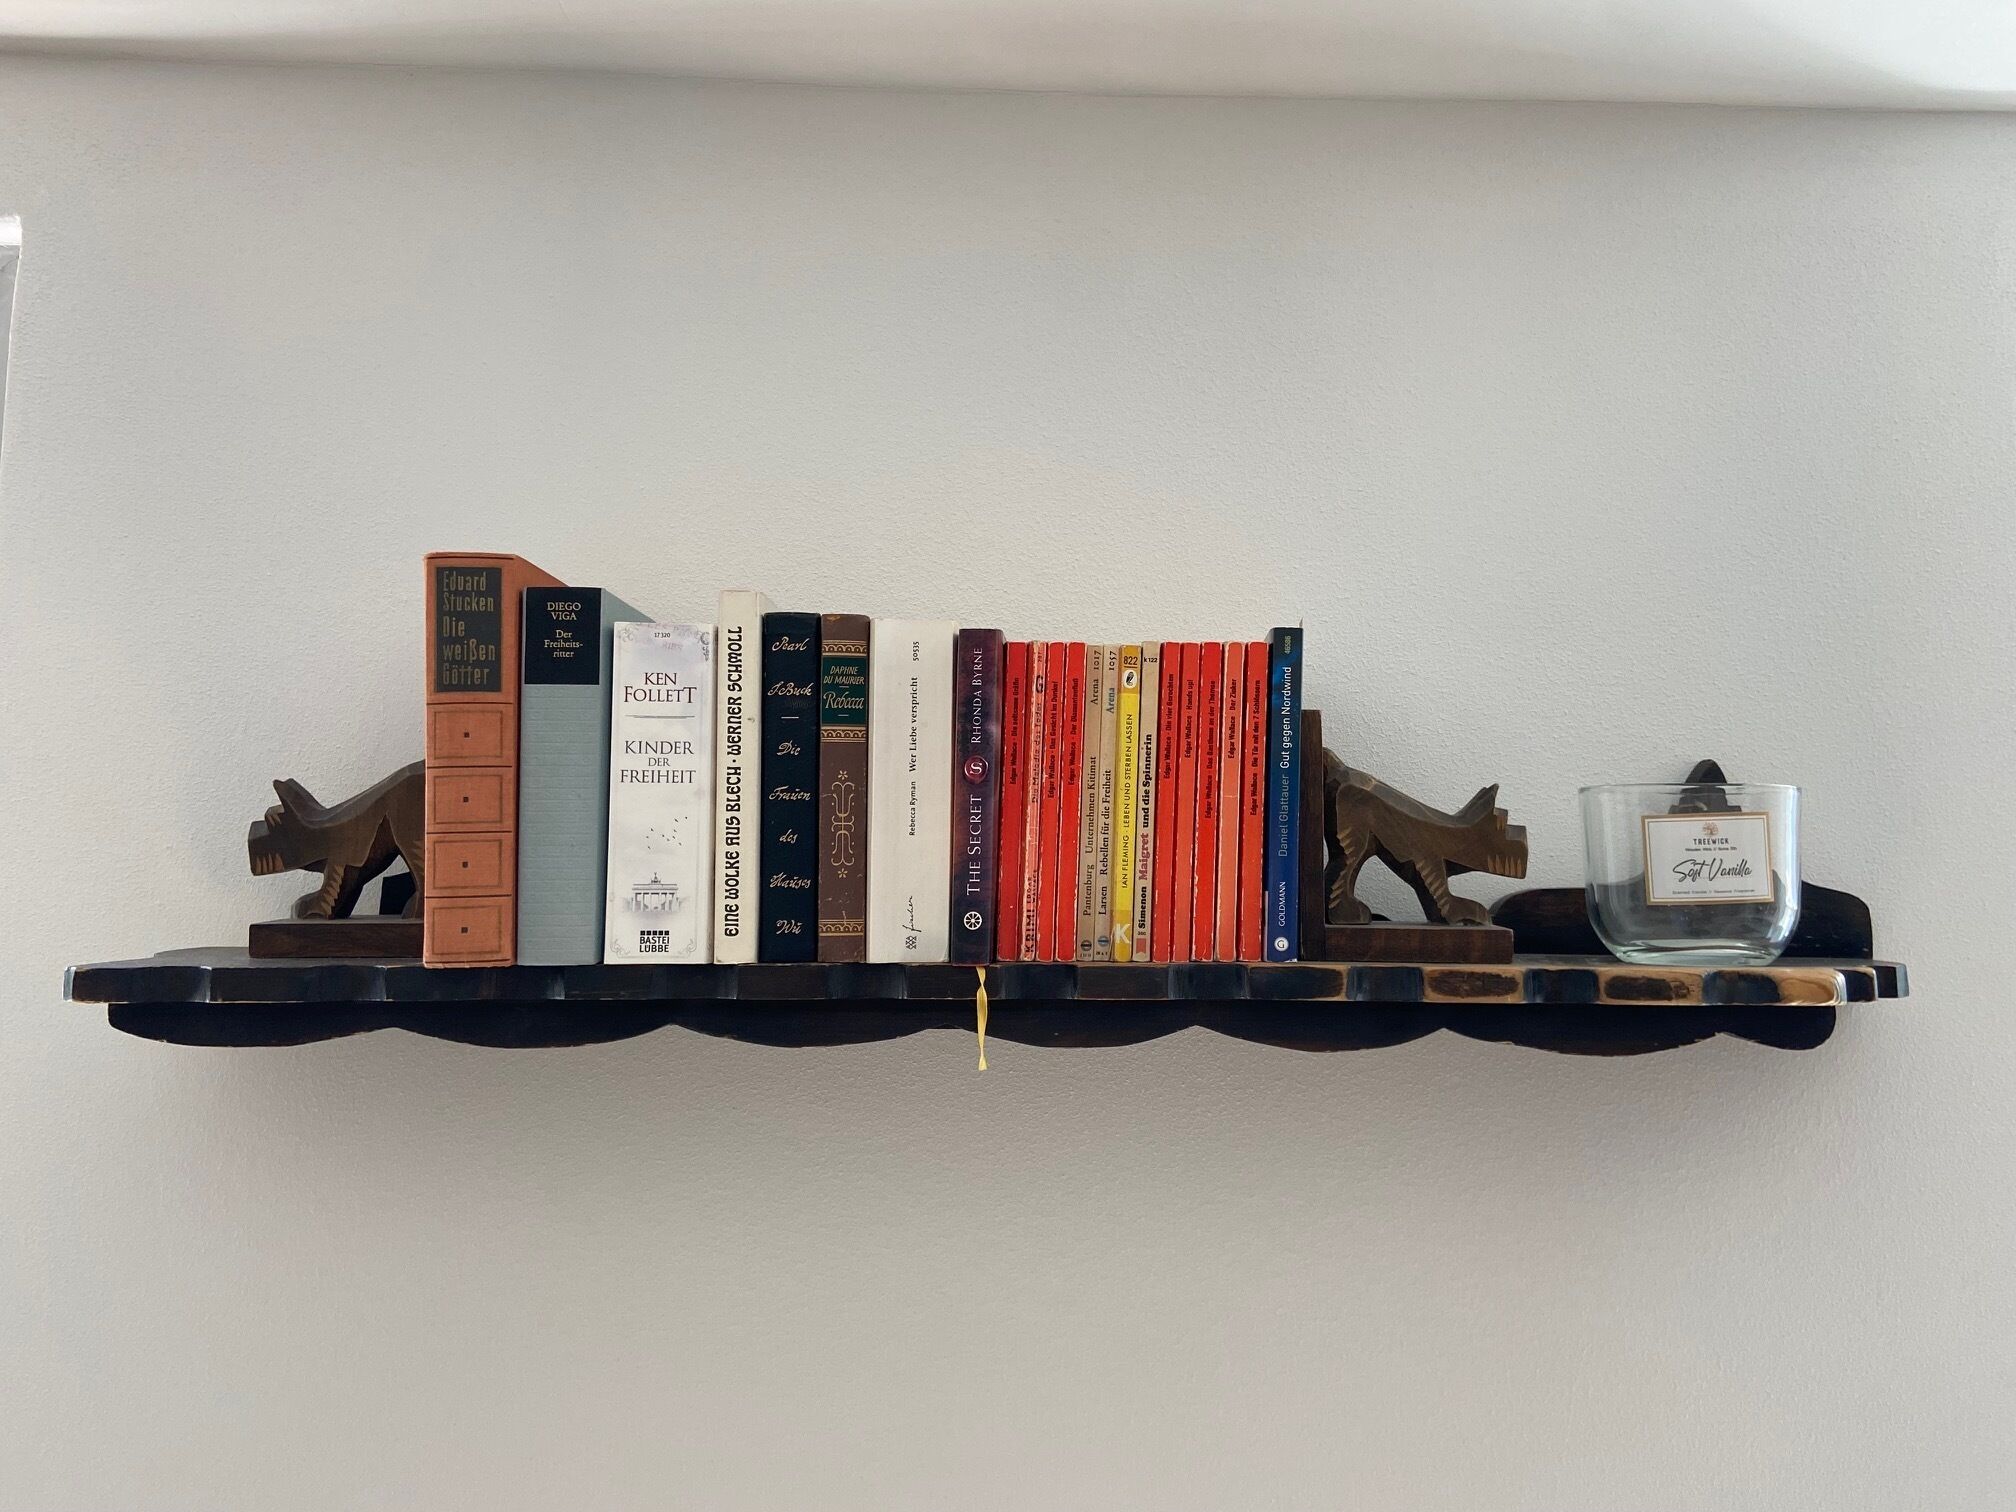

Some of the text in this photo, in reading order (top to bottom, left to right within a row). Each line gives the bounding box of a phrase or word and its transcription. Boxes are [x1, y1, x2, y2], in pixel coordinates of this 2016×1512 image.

[443, 571, 486, 591] Eduard
[443, 594, 494, 611] Stucken
[551, 612, 576, 620] VIGA
[443, 616, 464, 637] Die
[556, 630, 572, 638] Der
[443, 639, 495, 663] weißen
[544, 640, 583, 648] Freiheits-
[772, 637, 809, 650] Pearl
[553, 650, 574, 658] ritter
[1124, 656, 1138, 665] 822
[443, 664, 489, 684] Götter
[645, 673, 677, 685] KEN
[830, 666, 858, 674] DAPHNE
[835, 676, 864, 684] MAURIER
[624, 686, 697, 703] FOLLETT
[823, 691, 864, 708] Rebecca
[910, 678, 918, 723] verspricht
[971, 648, 983, 743] RHONDA BYRNE
[1091, 679, 1099, 705] Arena
[1106, 688, 1115, 713] Arena
[1280, 667, 1294, 768] Gut gegen Nordwind
[625, 741, 694, 754] KINDER
[909, 726, 917, 750] Liebe
[777, 741, 800, 755] Die
[648, 757, 670, 767] DER
[909, 753, 917, 772] Wer
[1142, 734, 1153, 787] Spinnerin
[620, 770, 696, 783] FREIHEIT
[725, 626, 742, 936] EINE WOLKE AUS BLECH WERNER SCHMOLL
[1123, 782, 1131, 801] UND
[1142, 789, 1150, 805] die
[1278, 774, 1289, 856] Daniel Glattauer
[780, 829, 797, 843] des
[967, 794, 982, 895] THE SECRET
[1083, 757, 1096, 916] Pantenburg Unternehmen Kitimat
[1099, 770, 1112, 915] Larsen Rebellen für die Freiheit
[1139, 833, 1149, 880] Maigret
[1673, 858, 1752, 882] Soft Vanilla
[1138, 886, 1147, 928] Simenon
[640, 944, 669, 952] LÜBBE
